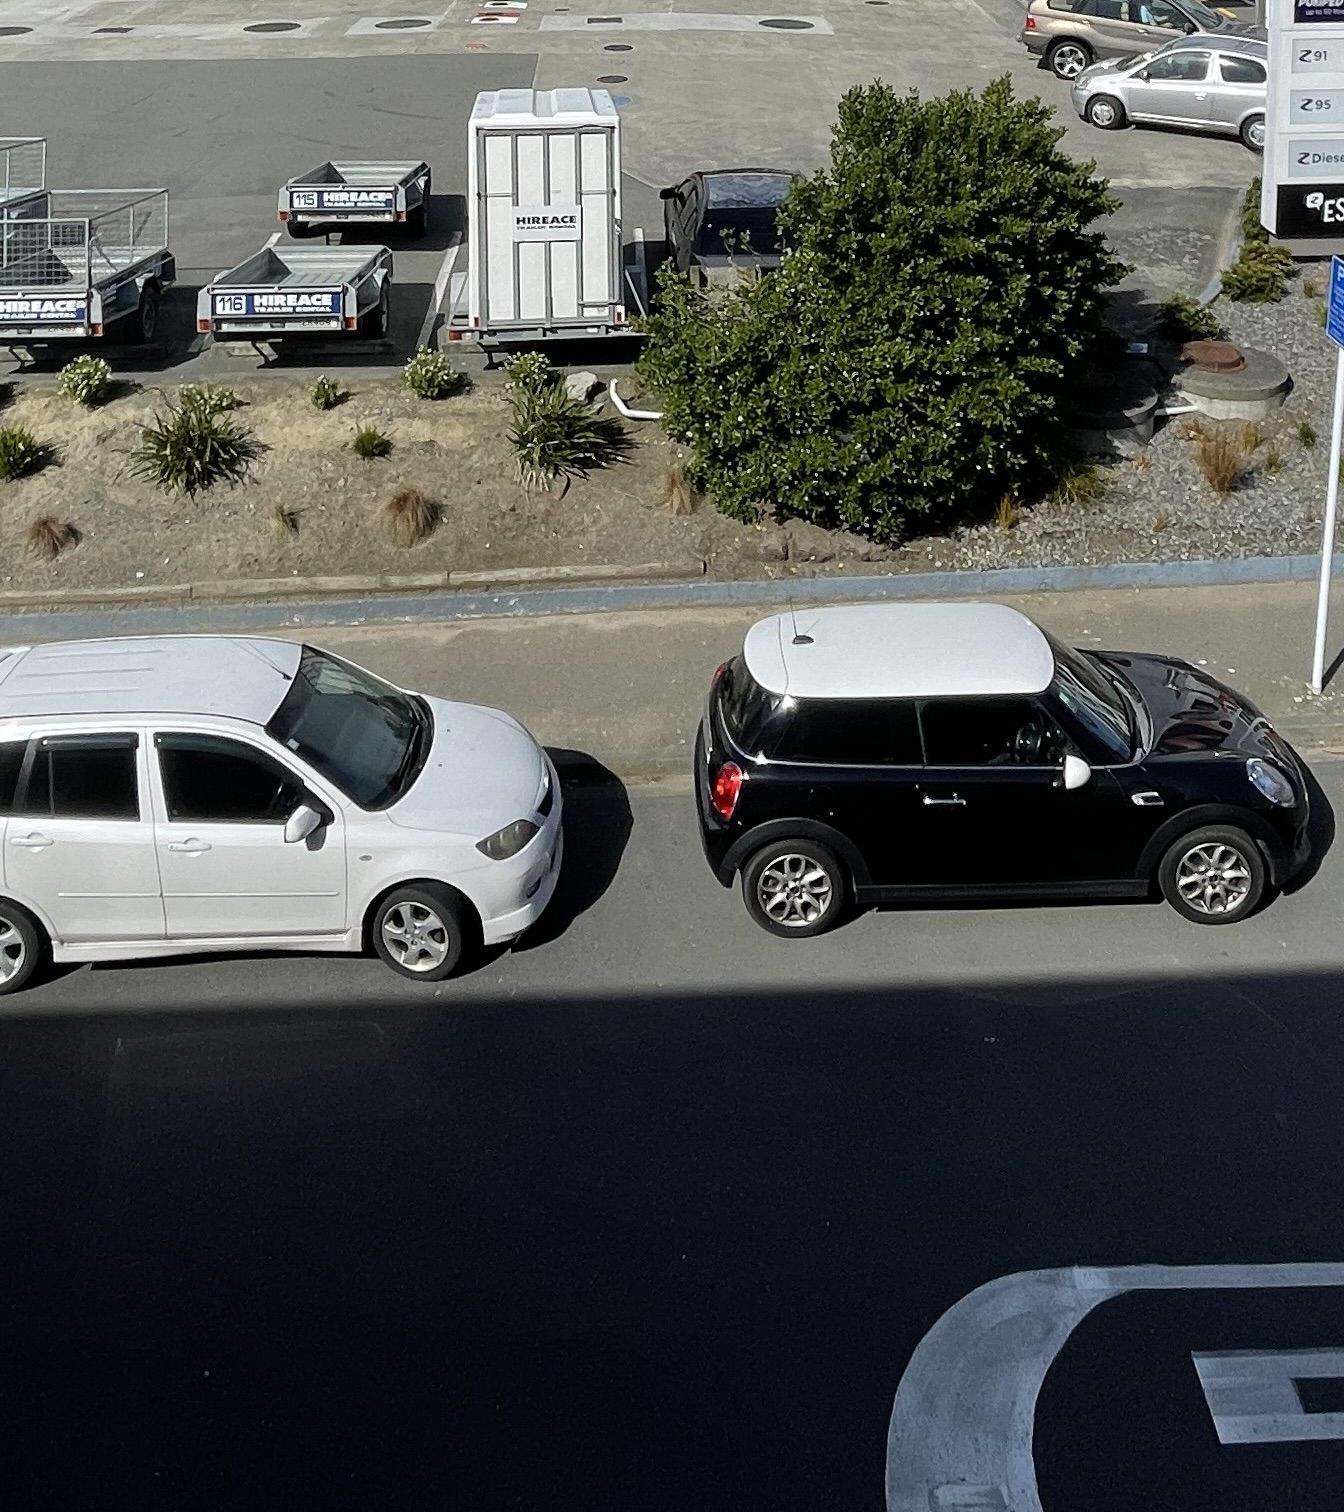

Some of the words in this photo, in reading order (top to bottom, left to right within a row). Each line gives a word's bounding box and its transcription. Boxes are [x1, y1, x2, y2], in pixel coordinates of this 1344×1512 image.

[1313, 50, 1328, 62] 91
[1315, 99, 1332, 110] 95
[295, 193, 315, 206] 115
[323, 191, 387, 202] HIREACE
[516, 215, 578, 225] HIREACE
[218, 296, 244, 312] 116
[253, 294, 333, 307] HIREACE
